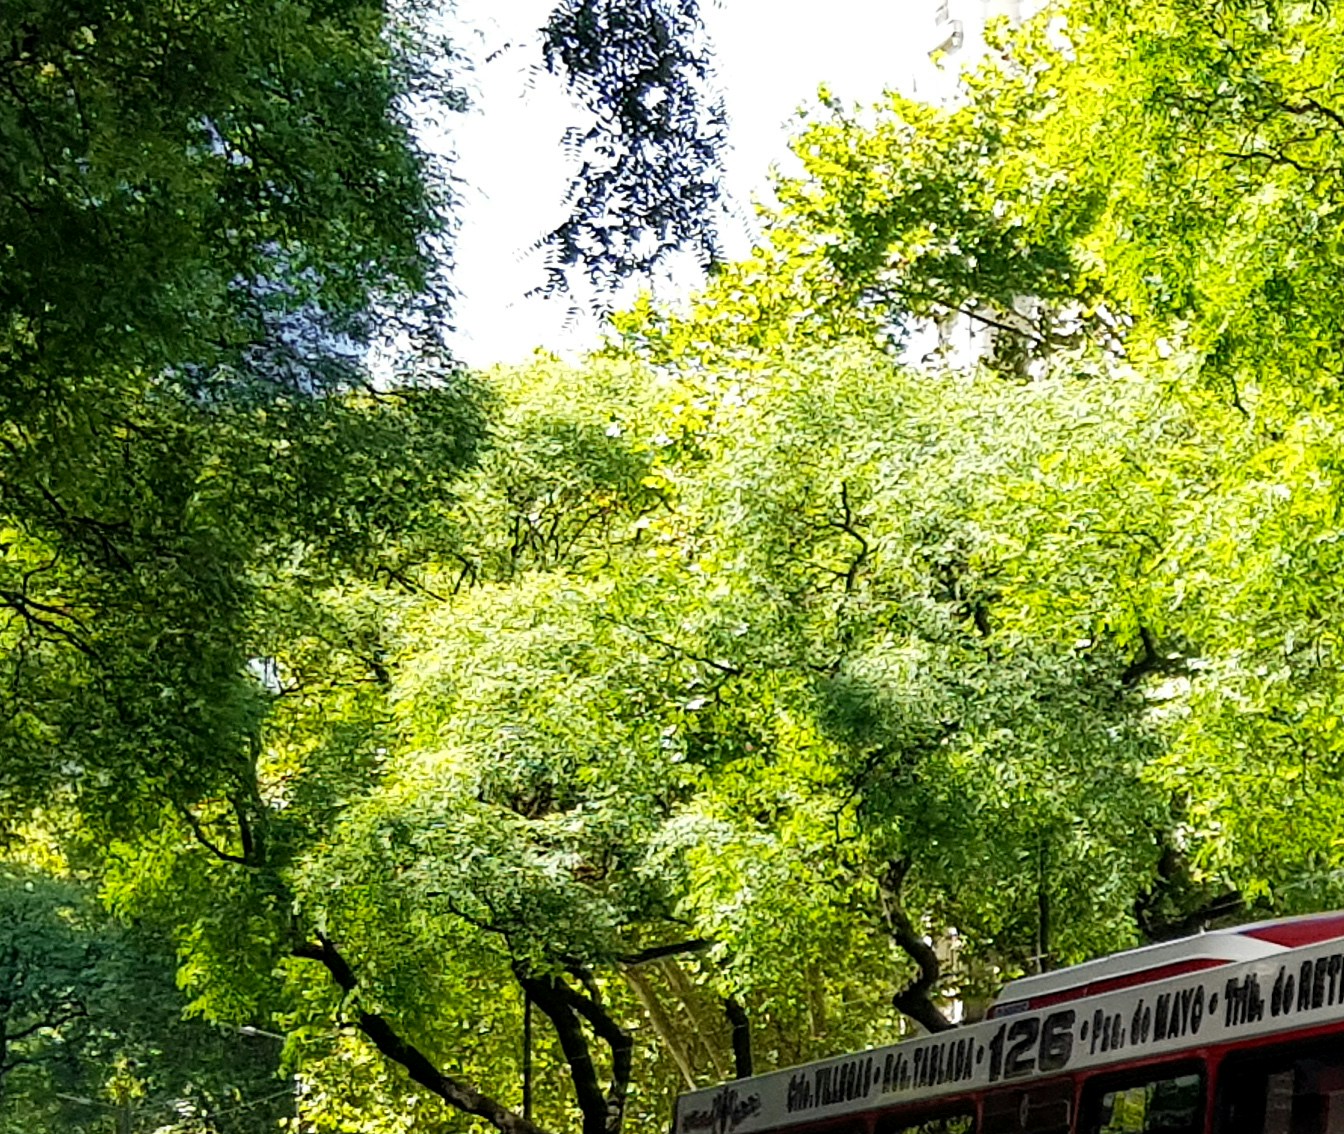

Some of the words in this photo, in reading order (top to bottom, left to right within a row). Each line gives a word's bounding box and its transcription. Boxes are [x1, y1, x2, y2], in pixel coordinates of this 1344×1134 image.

[989, 1010, 1075, 1082] 126
[1153, 985, 1205, 1042] MAYO
[1271, 966, 1295, 1017] de
